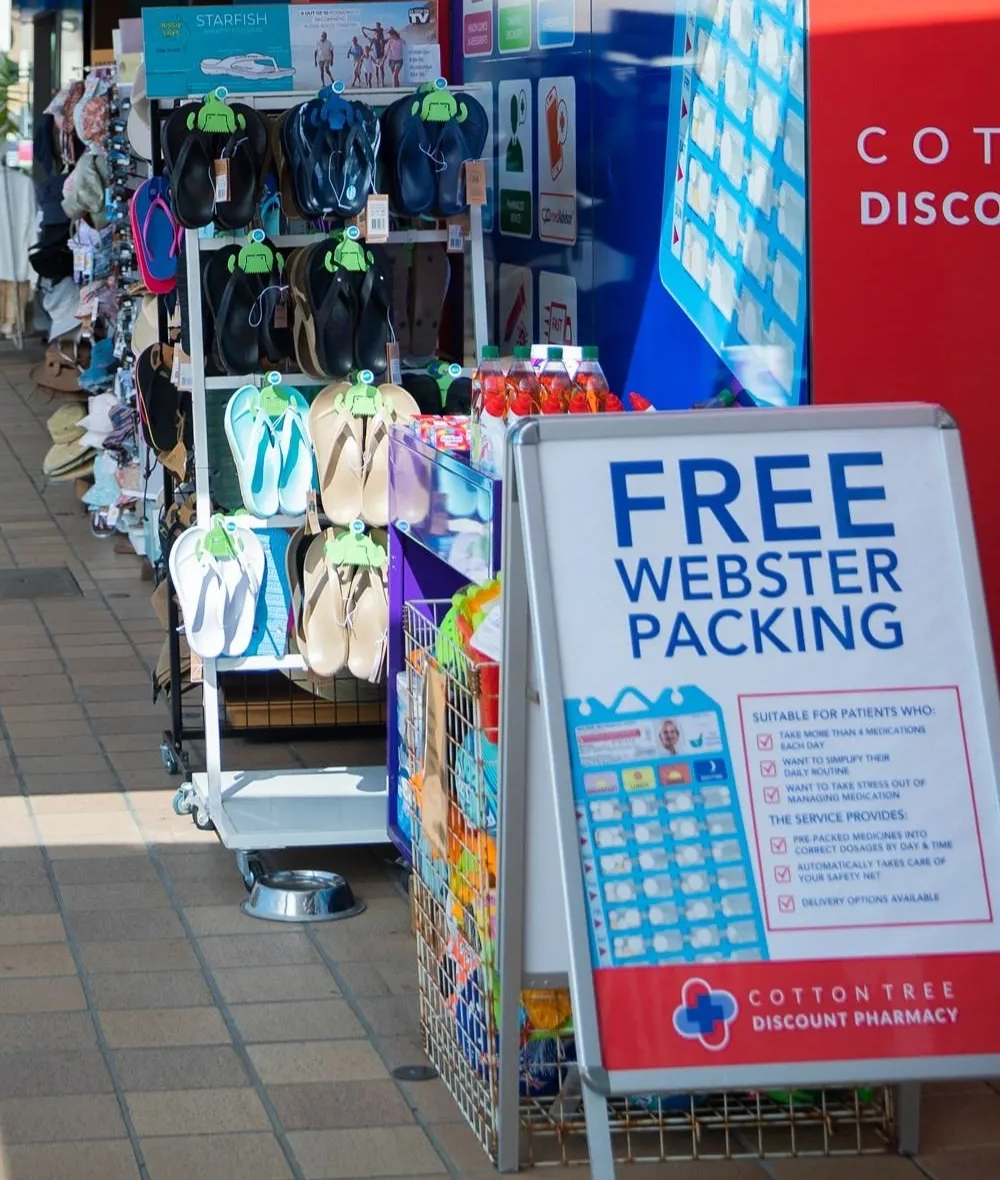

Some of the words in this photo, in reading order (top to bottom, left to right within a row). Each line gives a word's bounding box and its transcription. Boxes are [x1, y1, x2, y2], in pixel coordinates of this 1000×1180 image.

[196, 13, 268, 27] STARFISH
[609, 451, 896, 548] FREE
[614, 548, 903, 603] WEBSTER
[628, 602, 904, 660] PACKING
[753, 709, 809, 723] SUITABLE
[813, 708, 837, 720] FOR
[841, 706, 897, 719] PATIENTS
[901, 705, 936, 717] WHO:
[780, 730, 802, 739] TAKE
[804, 729, 829, 738] MORE
[832, 728, 857, 737] THAN
[865, 725, 927, 736] MEDICATIONS
[780, 742, 805, 751] EACH
[807, 741, 825, 751] DAY
[783, 757, 809, 766] WANT
[811, 756, 824, 765] TO
[826, 755, 863, 765] SIMPLIFY
[865, 754, 890, 763] THEIR
[784, 768, 809, 778] DAILY
[811, 766, 849, 777] ROUTINE
[786, 783, 813, 793] WANT
[816, 782, 829, 792] TO
[832, 781, 854, 791] TAKE
[857, 779, 889, 790] STRESS
[891, 778, 911, 789] OUT
[913, 778, 926, 788] OF
[787, 793, 840, 804] MANAGING
[842, 791, 900, 802] MEDICATION
[769, 814, 792, 825] THE
[795, 812, 843, 824] SERVICE
[847, 810, 908, 822] PROVIDES:
[852, 831, 902, 842] MEDICINES
[905, 830, 928, 840] INTO
[795, 845, 837, 855] CORRECT
[840, 843, 883, 854] DOSAGES
[886, 842, 897, 852] BY
[900, 841, 919, 851] DAY
[932, 840, 953, 850] TIME
[797, 860, 873, 871] AUTOMATICALLY
[876, 859, 905, 869] TAKES
[908, 857, 931, 867] CARE
[933, 857, 946, 866] OF
[798, 873, 824, 883] YOUR
[827, 872, 860, 882] SAFETY
[864, 871, 881, 881] NET
[801, 897, 844, 907] DELIVERY
[847, 895, 888, 906] OPTIONS
[891, 893, 939, 904] AVAILABLE
[748, 985, 869, 1007] COTTON
[882, 981, 956, 1001] TREE
[752, 1011, 847, 1032] DISCOUNT
[854, 1007, 958, 1027] PHARMACY
